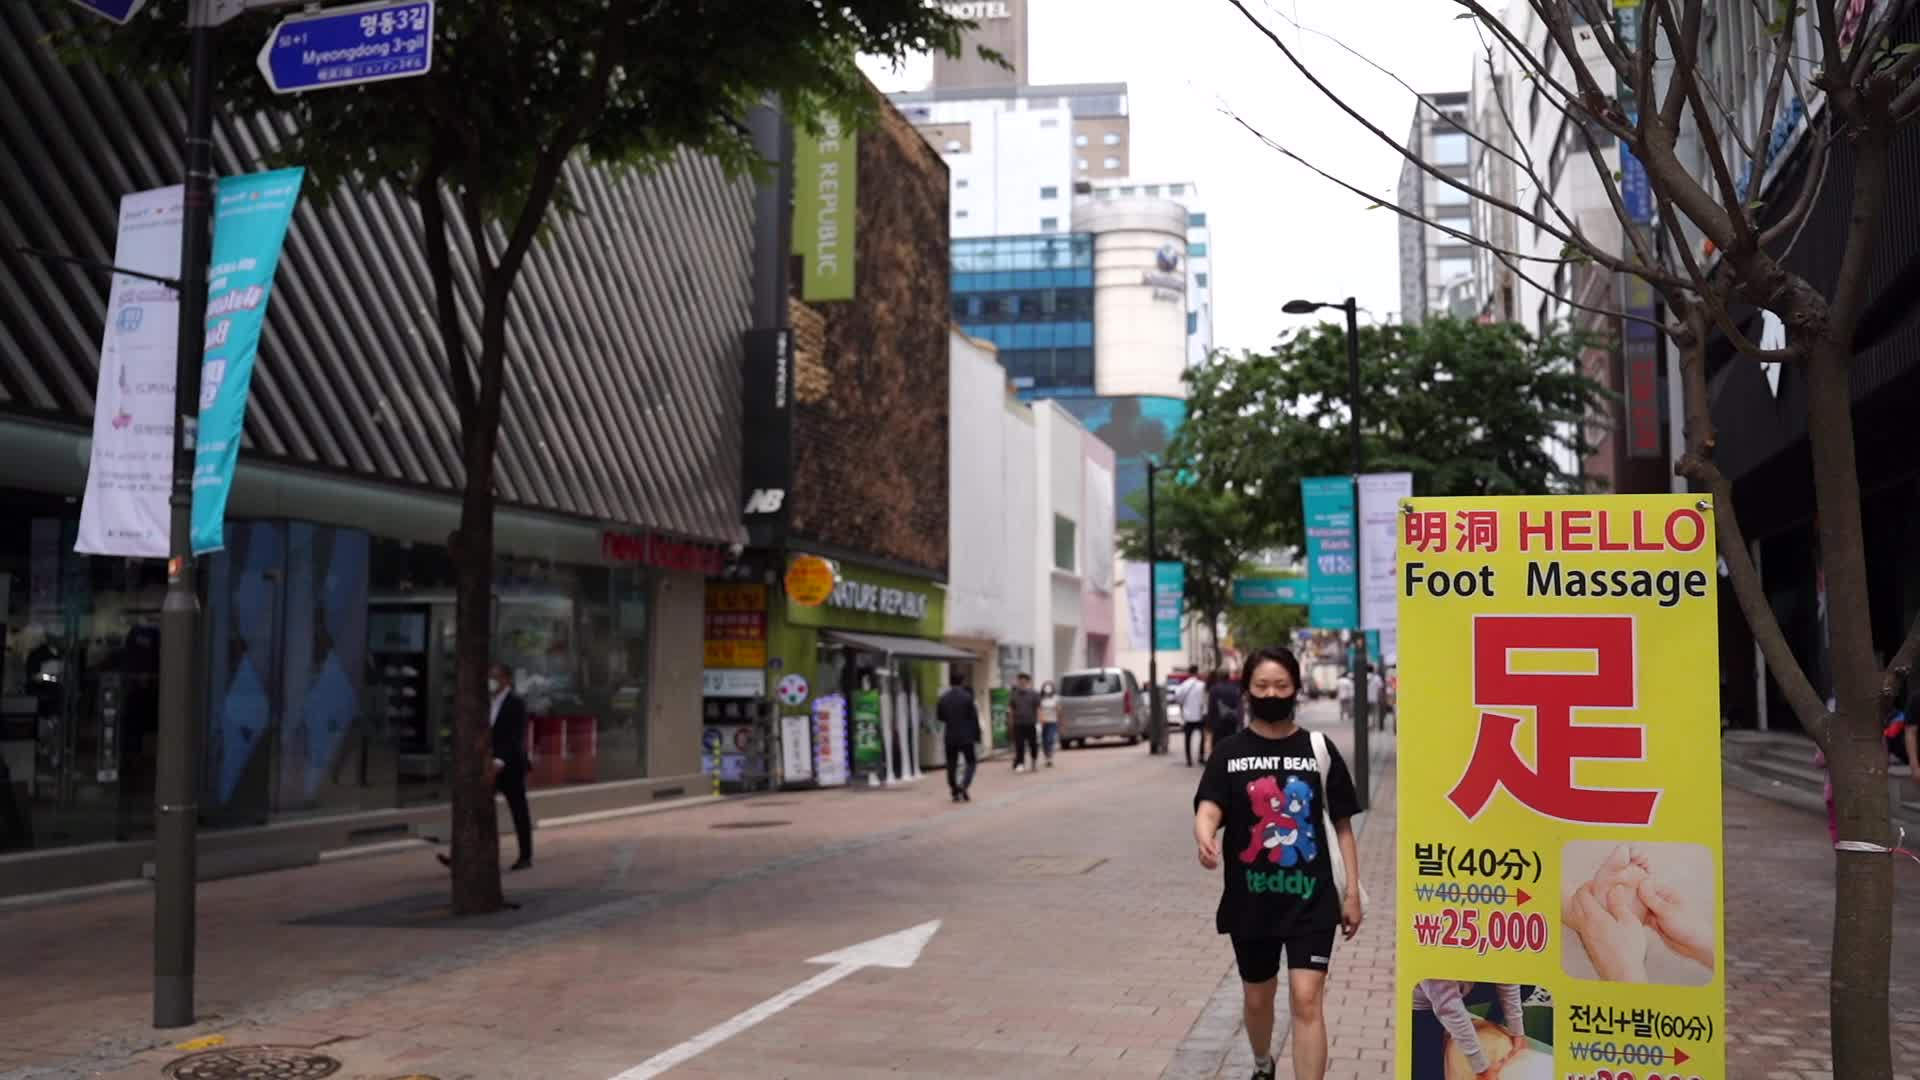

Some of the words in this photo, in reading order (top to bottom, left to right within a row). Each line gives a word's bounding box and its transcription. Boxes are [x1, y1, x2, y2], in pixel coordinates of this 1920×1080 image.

[360, 7, 426, 37] 명동3길
[303, 42, 390, 65] Myeongdong
[393, 35, 425, 53] 3-gil
[818, 162, 841, 276] REPUBLIC
[744, 488, 785, 514] NB
[1404, 509, 1498, 553] 明洞
[1518, 507, 1706, 553] HELLO
[1404, 560, 1496, 598] Foot
[1526, 560, 1708, 608] Massage
[1446, 615, 1662, 826] 足
[1227, 756, 1281, 773] INSTANT
[1414, 842, 1543, 884] 발(40分)
[1246, 870, 1317, 900] teddy
[1414, 882, 1507, 906] ₩40,000
[1413, 907, 1548, 956] ₩25,000
[1568, 1004, 1714, 1044] 전신+발(60分)
[1569, 1041, 1664, 1067] ₩60,000
